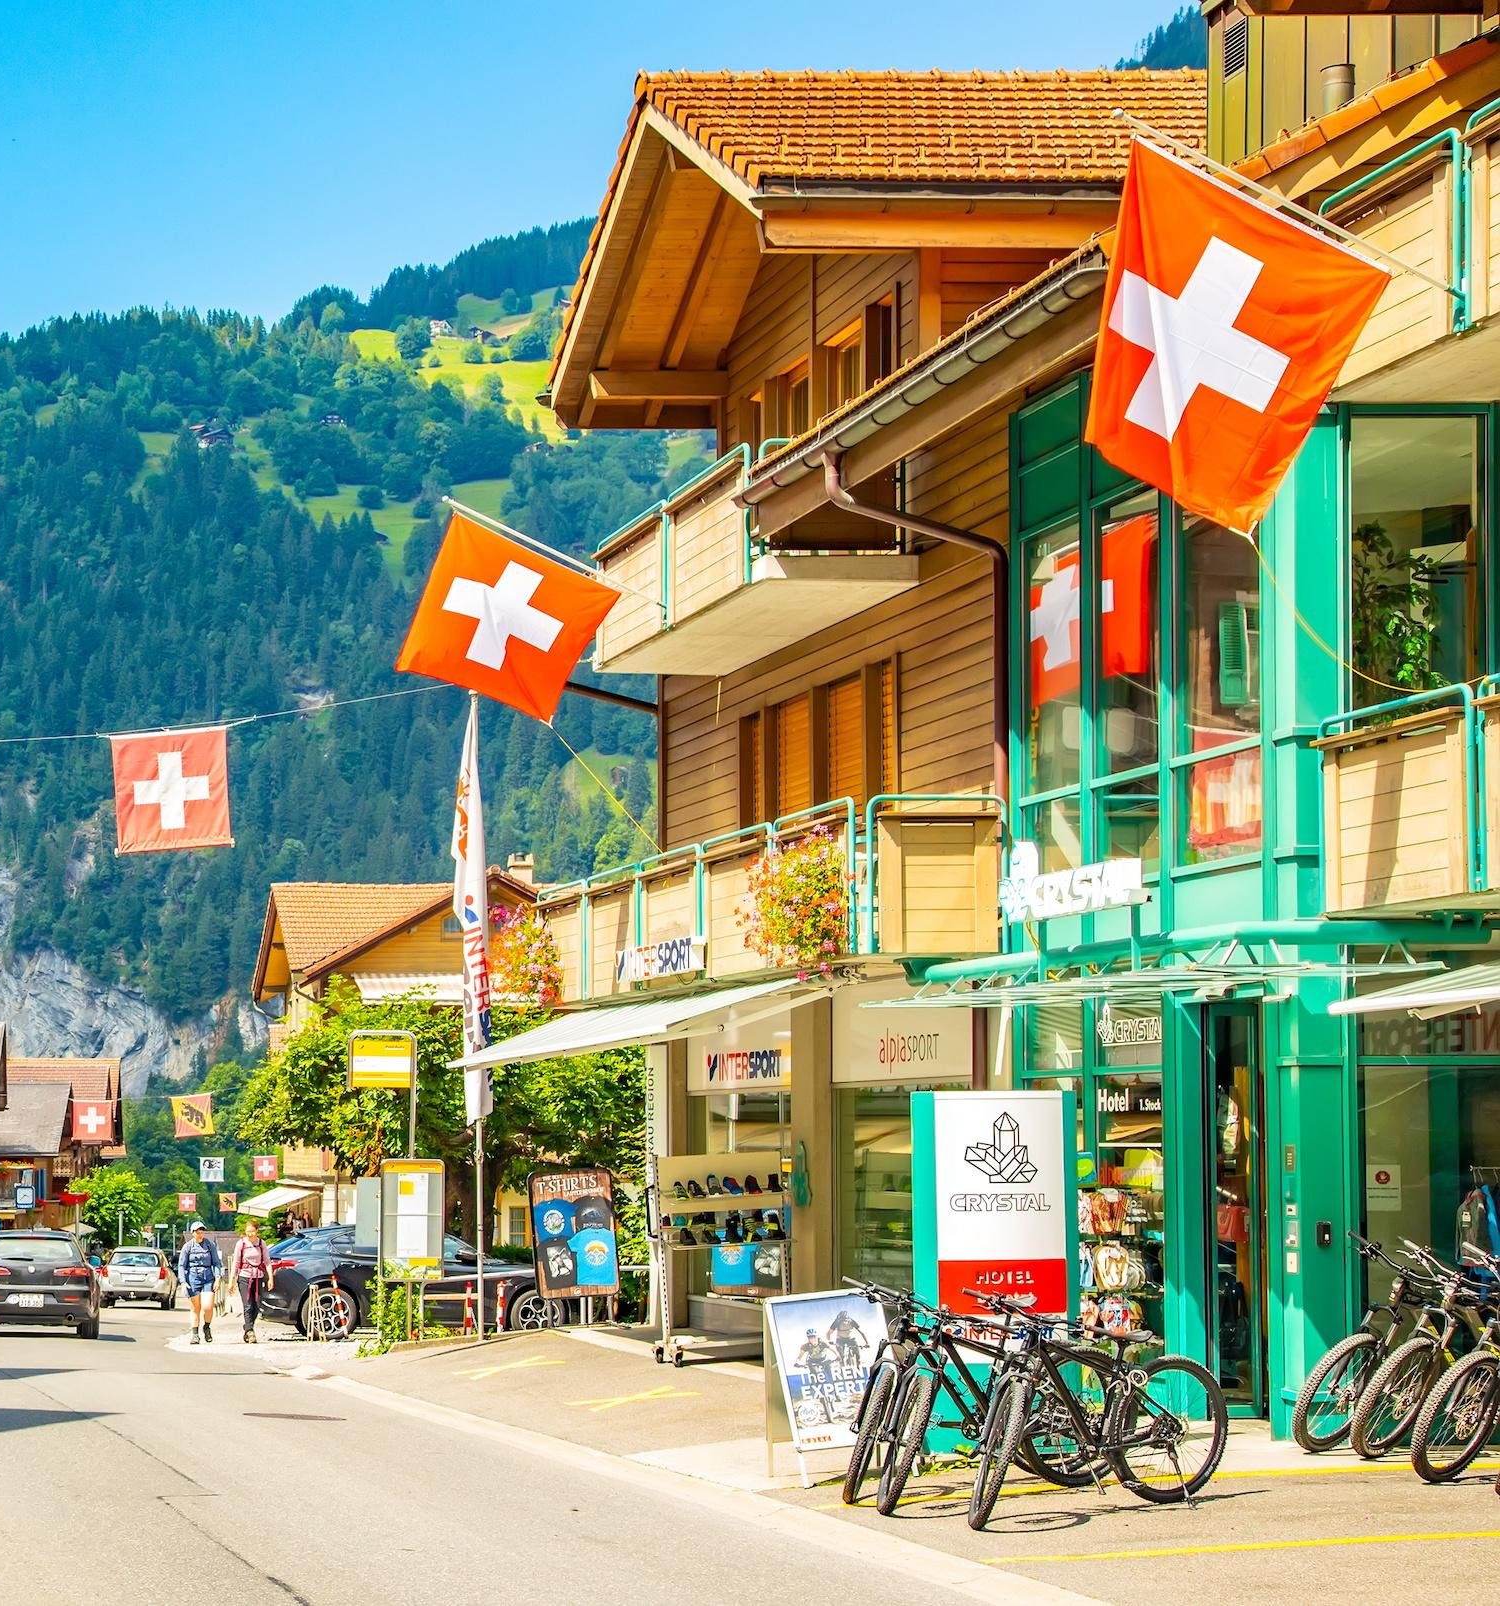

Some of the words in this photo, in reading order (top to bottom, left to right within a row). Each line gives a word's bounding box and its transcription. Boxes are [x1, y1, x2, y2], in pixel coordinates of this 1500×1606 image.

[1114, 1017, 1162, 1043] CRYSTA
[718, 1049, 782, 1082] INTERSPORT
[647, 1066, 656, 1122] REGION
[1097, 1088, 1130, 1113] Hotel
[536, 1174, 598, 1195] T-SHIRTS
[949, 1193, 1052, 1212] CRYSTAL
[976, 1271, 1035, 1285] HOTEL
[800, 1371, 826, 1385] The
[801, 1379, 869, 1401] EXPERT
